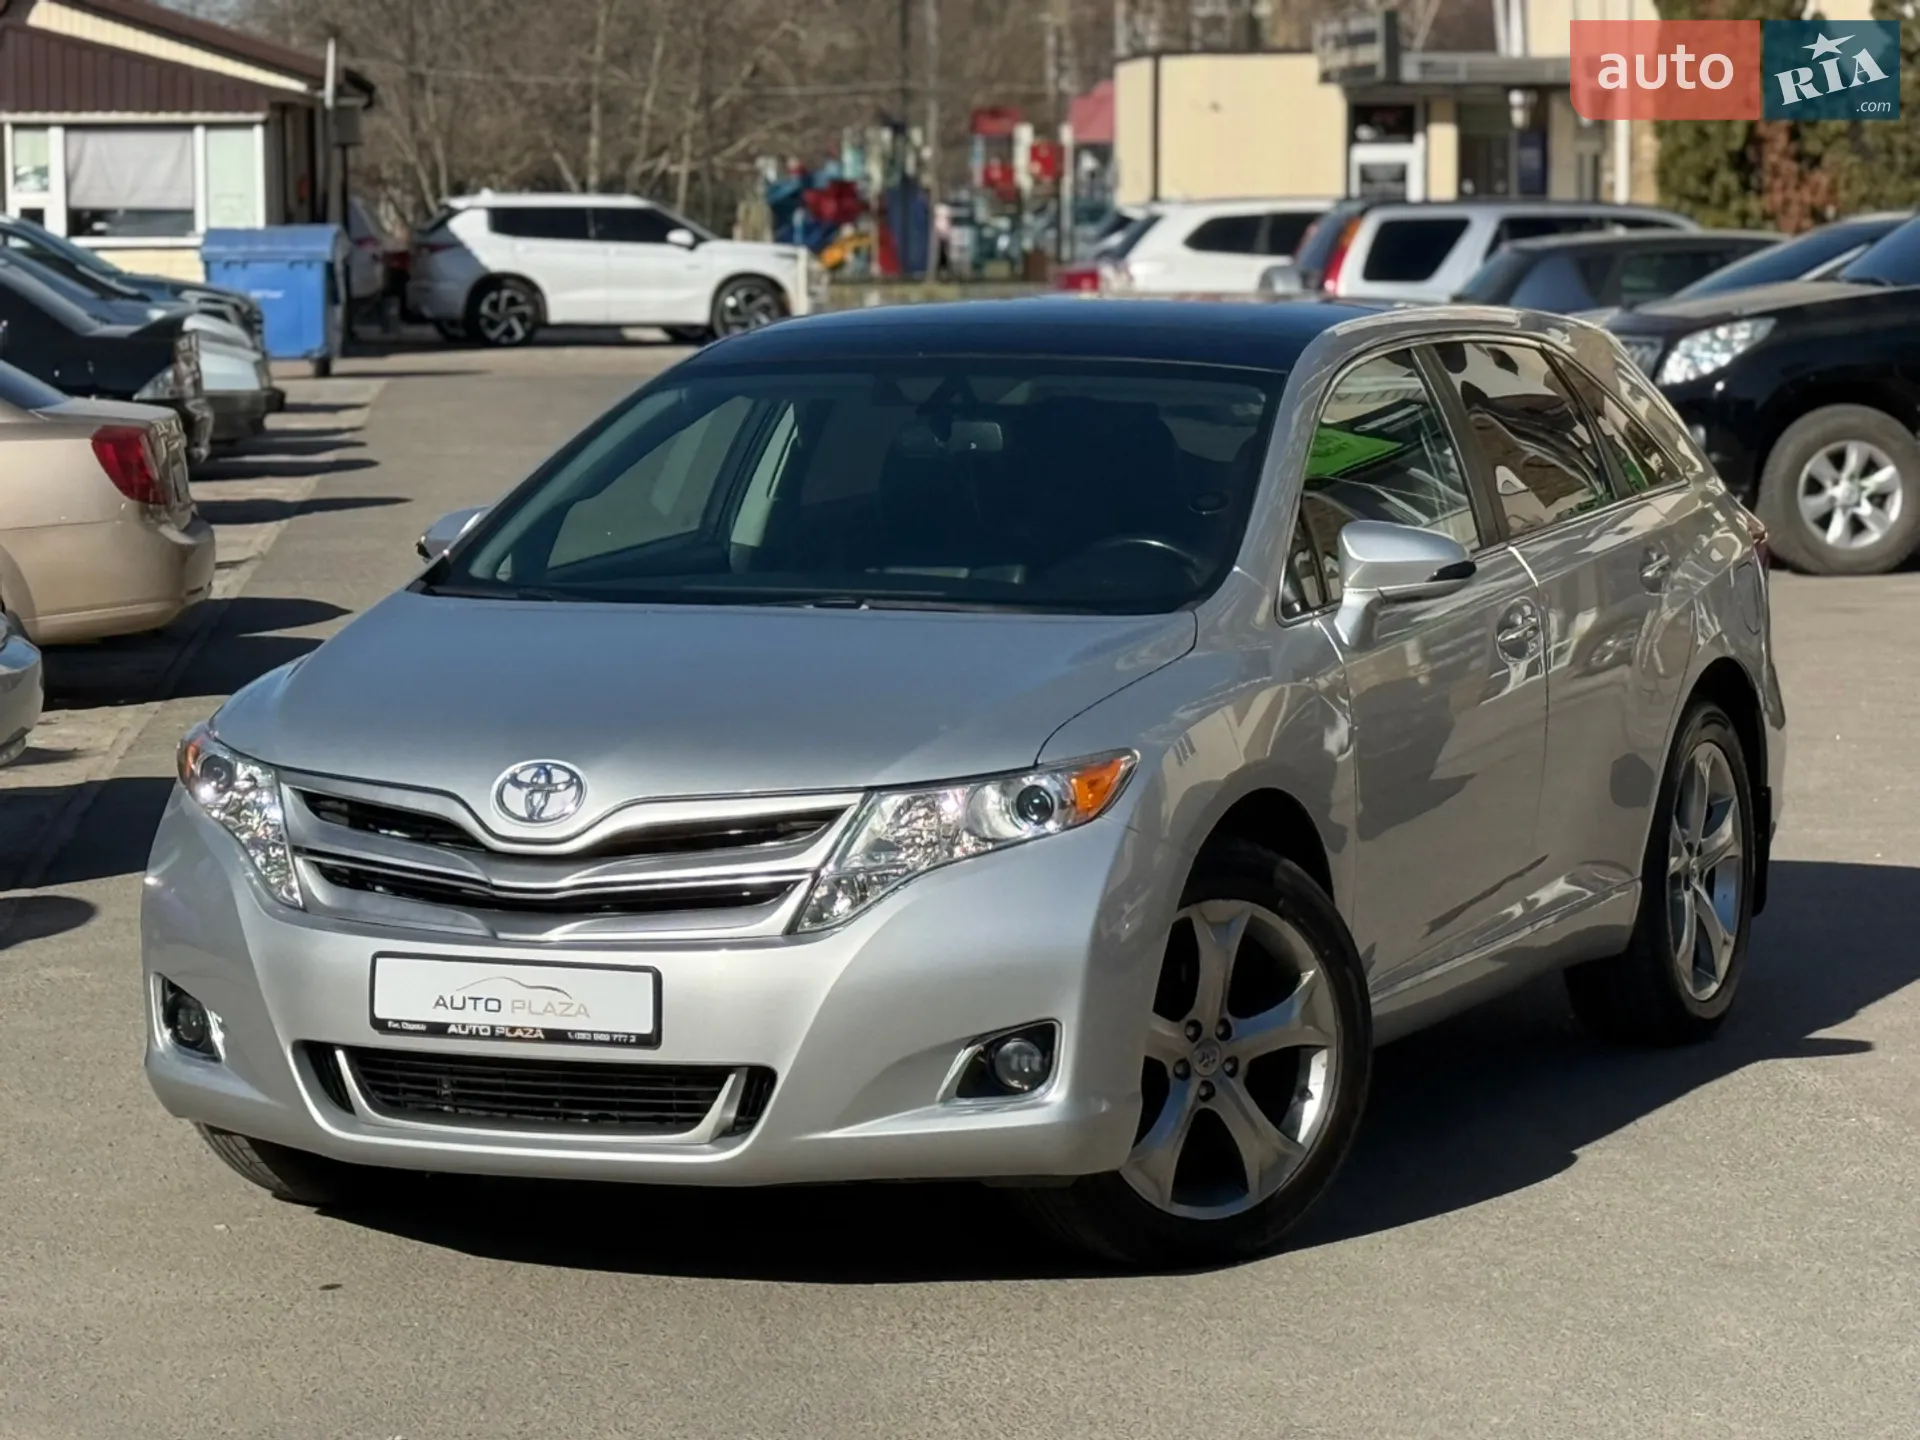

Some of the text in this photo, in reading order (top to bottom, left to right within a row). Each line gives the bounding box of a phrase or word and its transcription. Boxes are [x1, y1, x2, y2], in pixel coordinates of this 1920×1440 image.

[433, 994, 591, 1019] AUTO PLAZA
[447, 1023, 545, 1040] AUTO PLAZA
